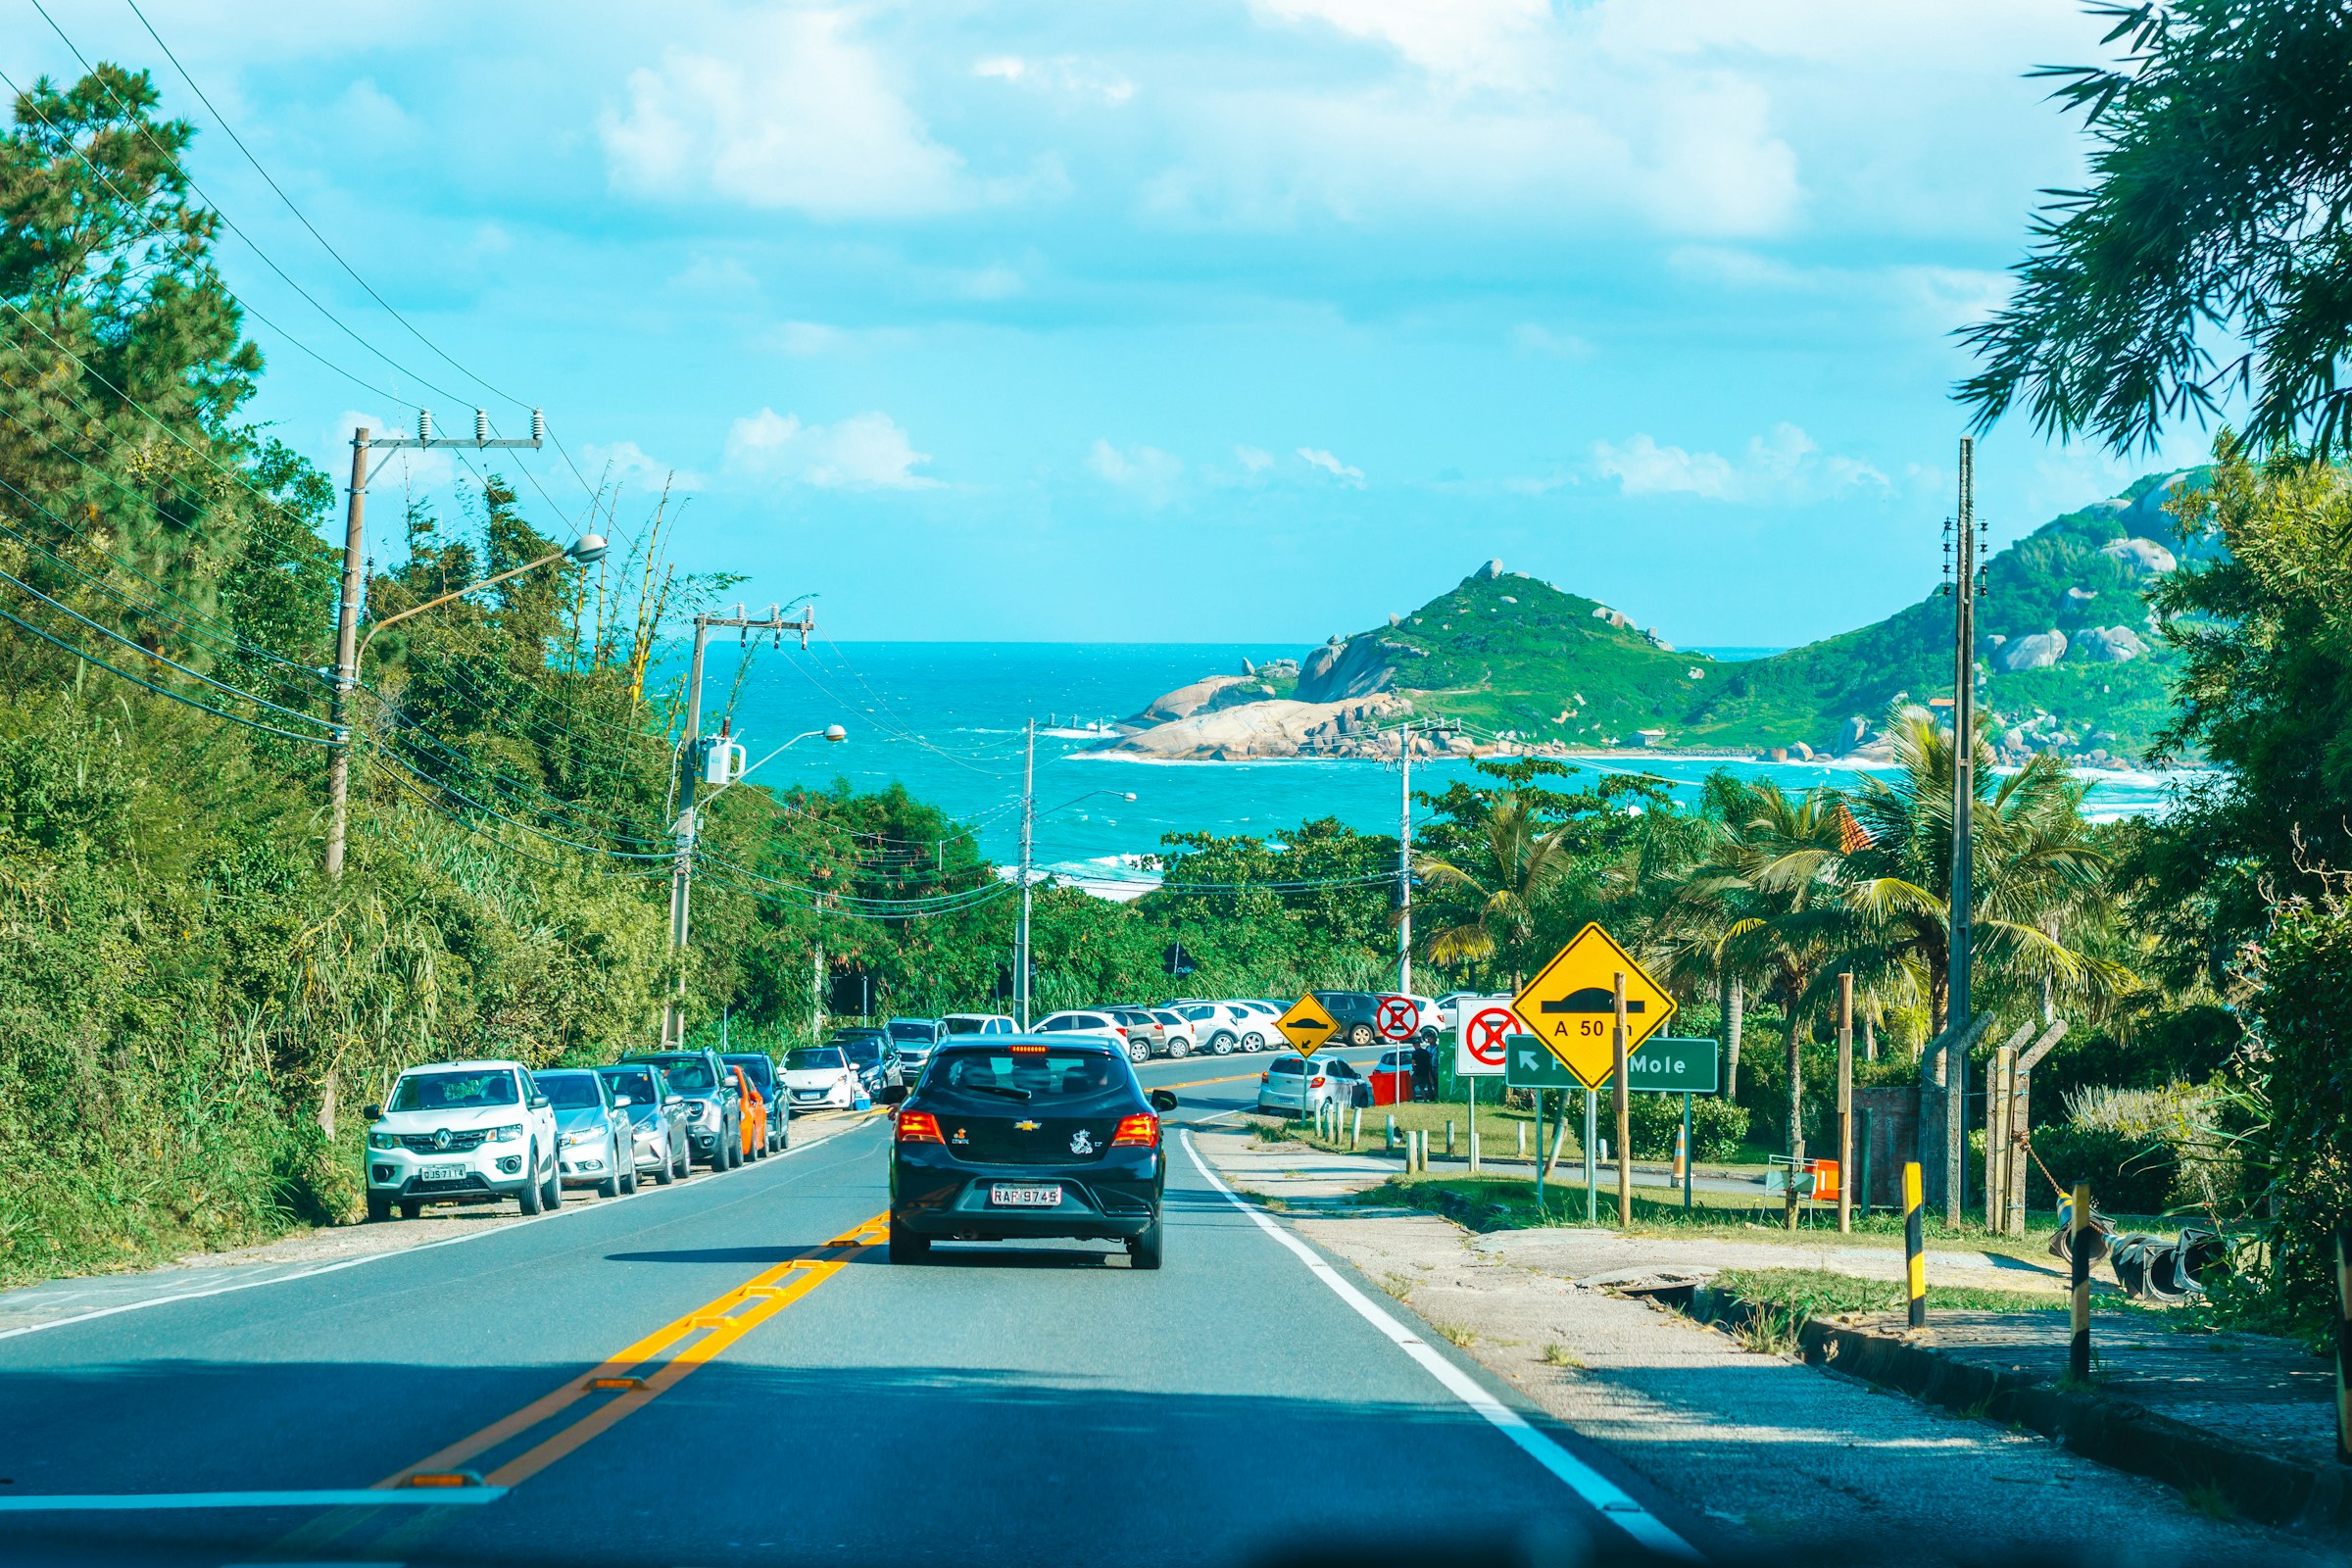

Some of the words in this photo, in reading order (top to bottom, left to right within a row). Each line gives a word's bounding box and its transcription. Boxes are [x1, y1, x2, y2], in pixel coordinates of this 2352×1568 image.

[1554, 1021, 1568, 1036] A
[1580, 1021, 1603, 1036] 50
[1630, 1054, 1686, 1073] Mole
